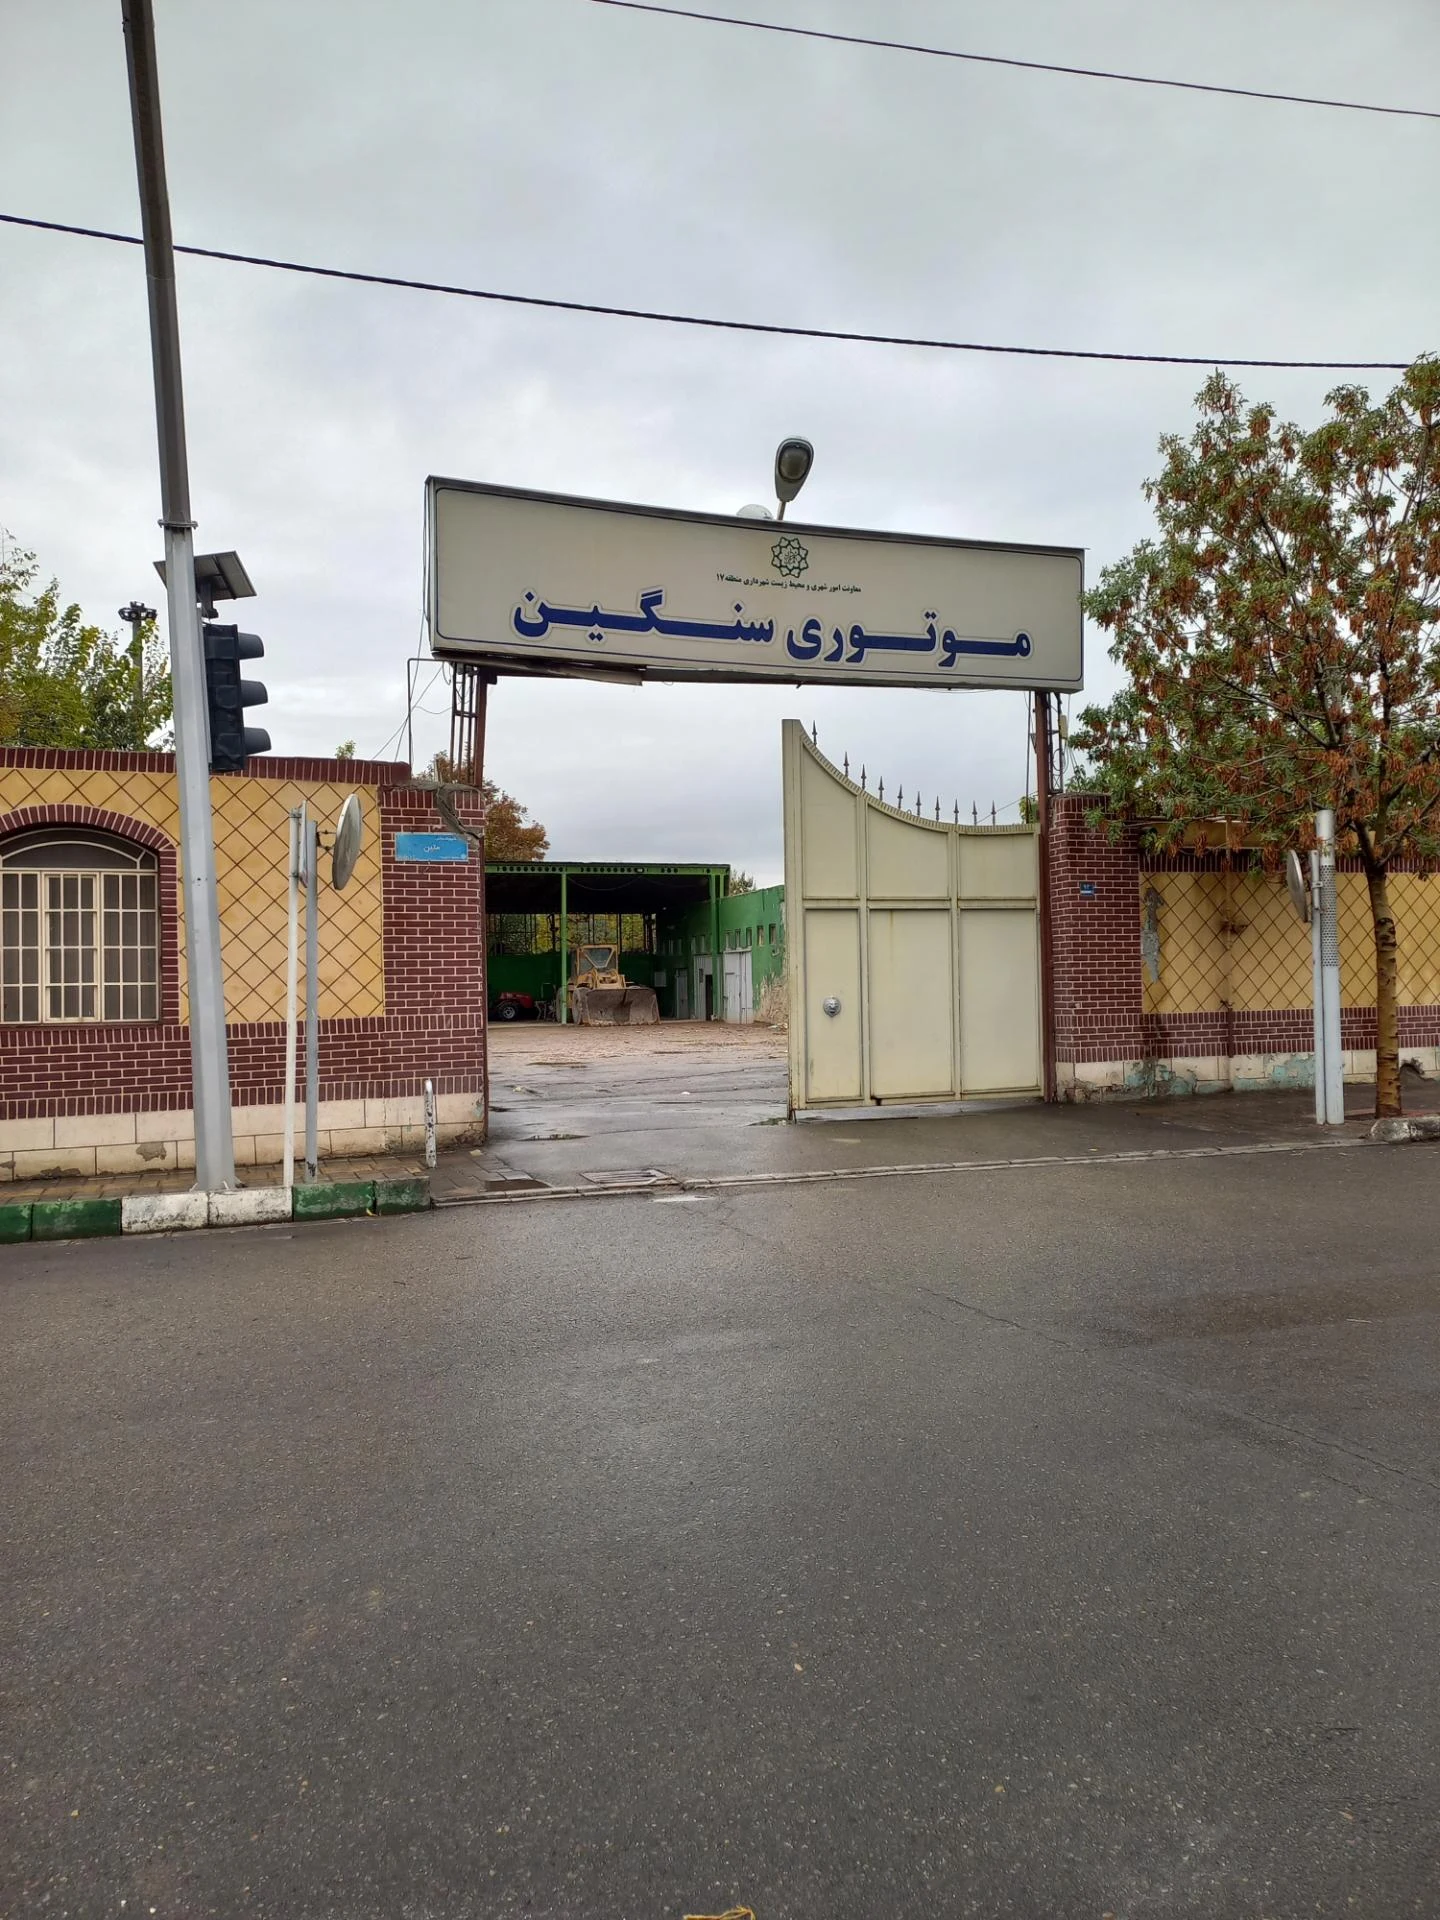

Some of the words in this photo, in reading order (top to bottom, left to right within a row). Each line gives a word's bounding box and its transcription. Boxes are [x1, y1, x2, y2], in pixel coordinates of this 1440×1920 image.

[743, 577, 769, 587] شهرداری
[771, 579, 788, 589] زیست
[789, 580, 805, 589] محیط
[811, 583, 828, 592] شهری
[829, 584, 841, 593] امور
[842, 585, 862, 594] معاونت
[512, 590, 774, 642] سنگین
[788, 610, 1031, 667] موتوری
